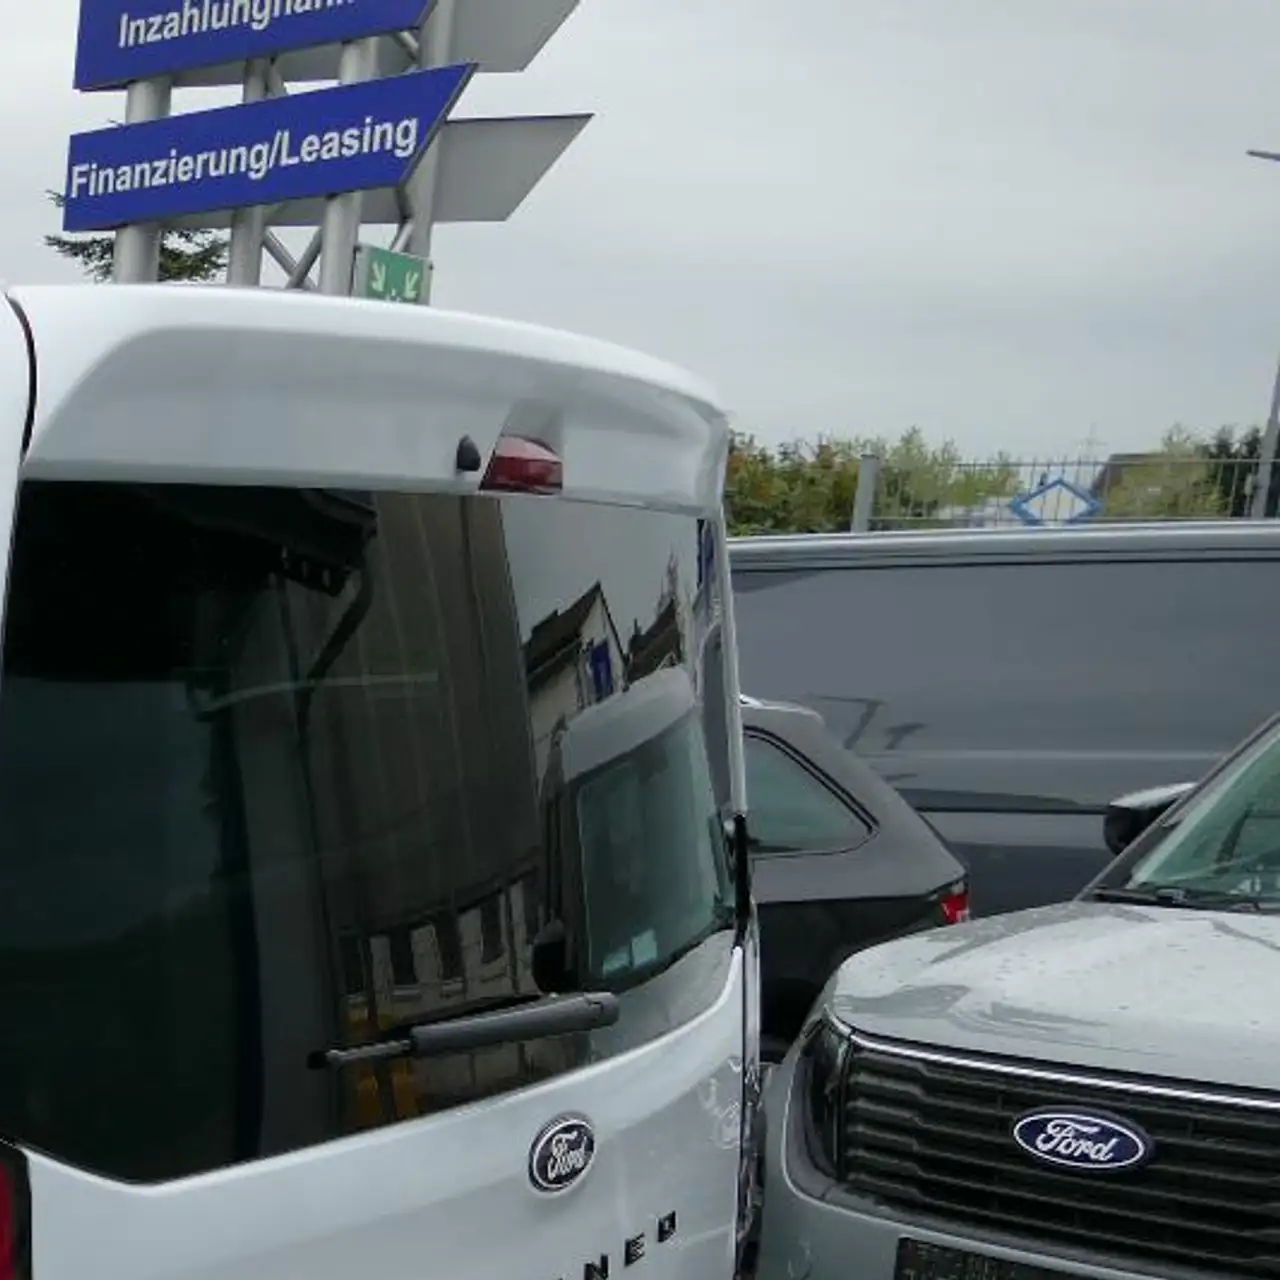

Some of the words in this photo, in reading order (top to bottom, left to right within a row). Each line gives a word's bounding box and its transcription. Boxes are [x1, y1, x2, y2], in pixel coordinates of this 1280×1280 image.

[70, 117, 418, 197] Finanzierung/Leasing
[546, 1130, 589, 1181] Ford
[1036, 1117, 1119, 1163] Ford
